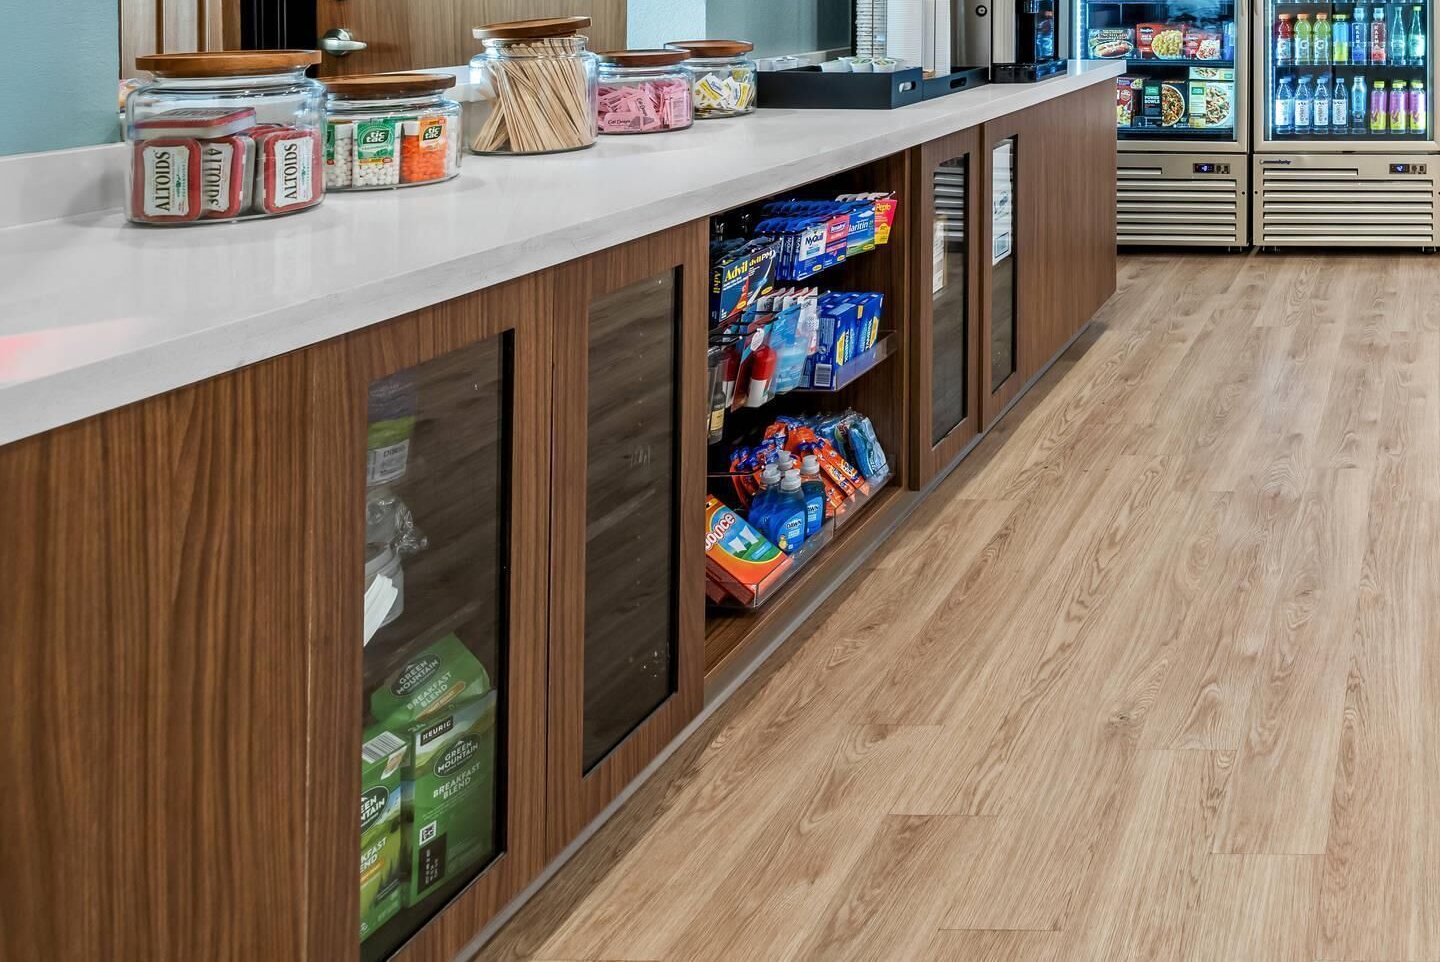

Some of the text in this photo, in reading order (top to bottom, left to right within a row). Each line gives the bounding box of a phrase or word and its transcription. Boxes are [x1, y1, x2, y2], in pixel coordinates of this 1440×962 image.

[366, 135, 386, 144] tac
[370, 130, 385, 139] tic
[428, 126, 440, 135] tic
[155, 150, 171, 212] ALTOIDS
[284, 142, 298, 200] ALTOIDS
[849, 221, 869, 233] laritin
[724, 260, 748, 282] Advil
[786, 519, 802, 530] DAWN
[396, 659, 439, 695] MOUNTAIN
[399, 659, 429, 686] GREEN
[406, 671, 453, 710] BREAKFAST
[421, 684, 449, 708] BLEND
[422, 719, 452, 741] KEURIG
[437, 743, 479, 774] MOUNTAIN
[444, 739, 473, 761] GREEN
[433, 762, 481, 799] BREAKFAST
[443, 776, 472, 800] BLEND
[361, 837, 387, 865] KFAST
